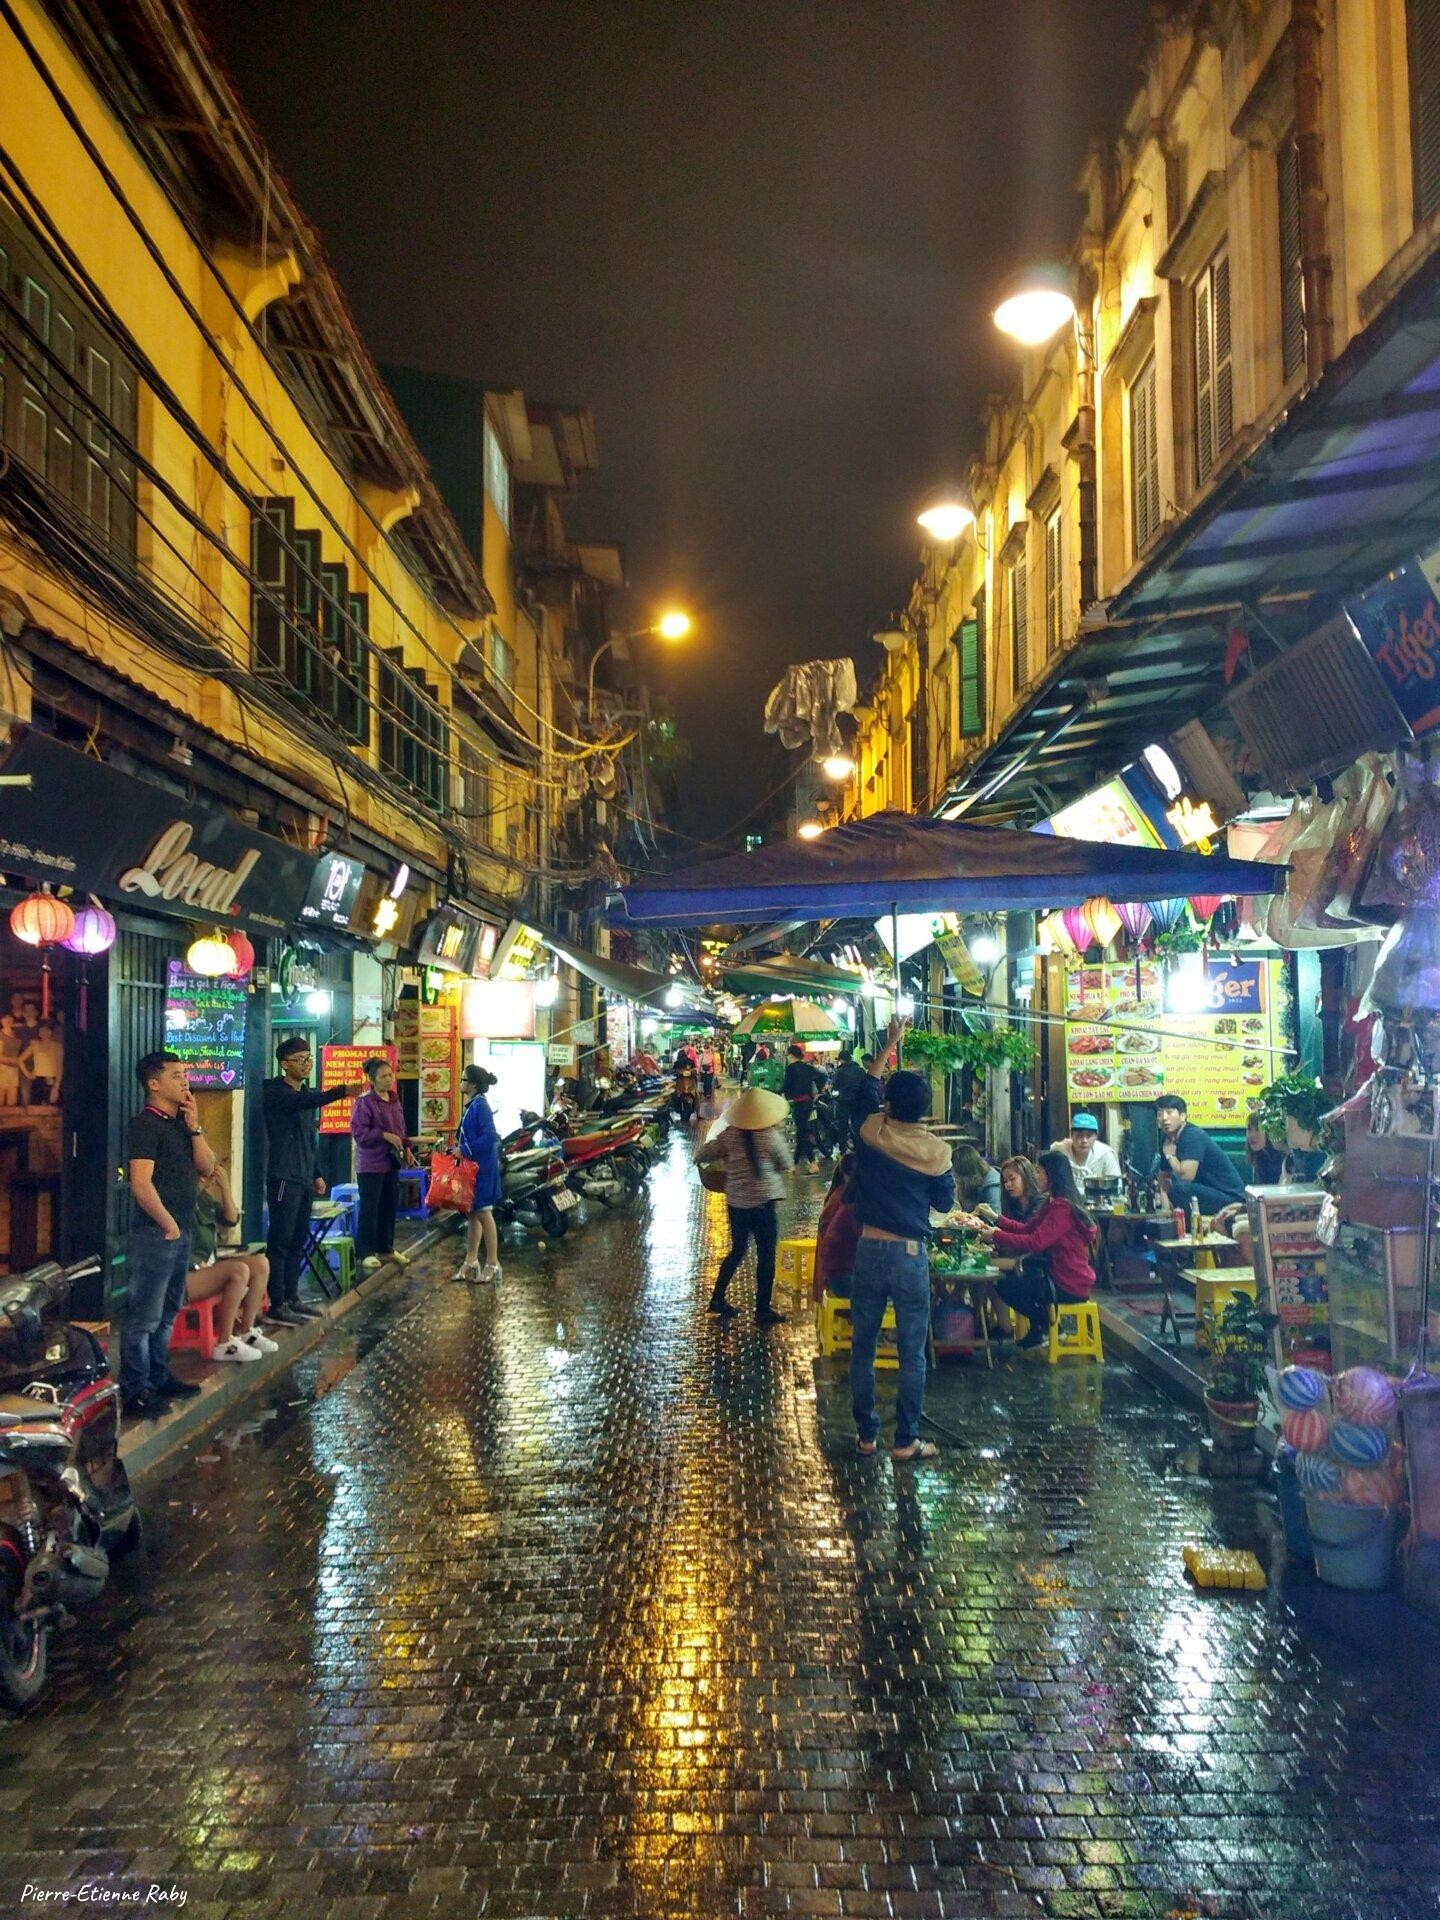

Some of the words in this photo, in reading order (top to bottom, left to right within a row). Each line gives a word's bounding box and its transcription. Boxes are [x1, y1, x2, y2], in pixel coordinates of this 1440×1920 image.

[119, 820, 262, 915] Local
[169, 975, 187, 992] Buy
[196, 979, 211, 993] get
[166, 1032, 182, 1043] Best
[184, 1031, 217, 1042] Discount
[325, 1060, 345, 1068] NEM
